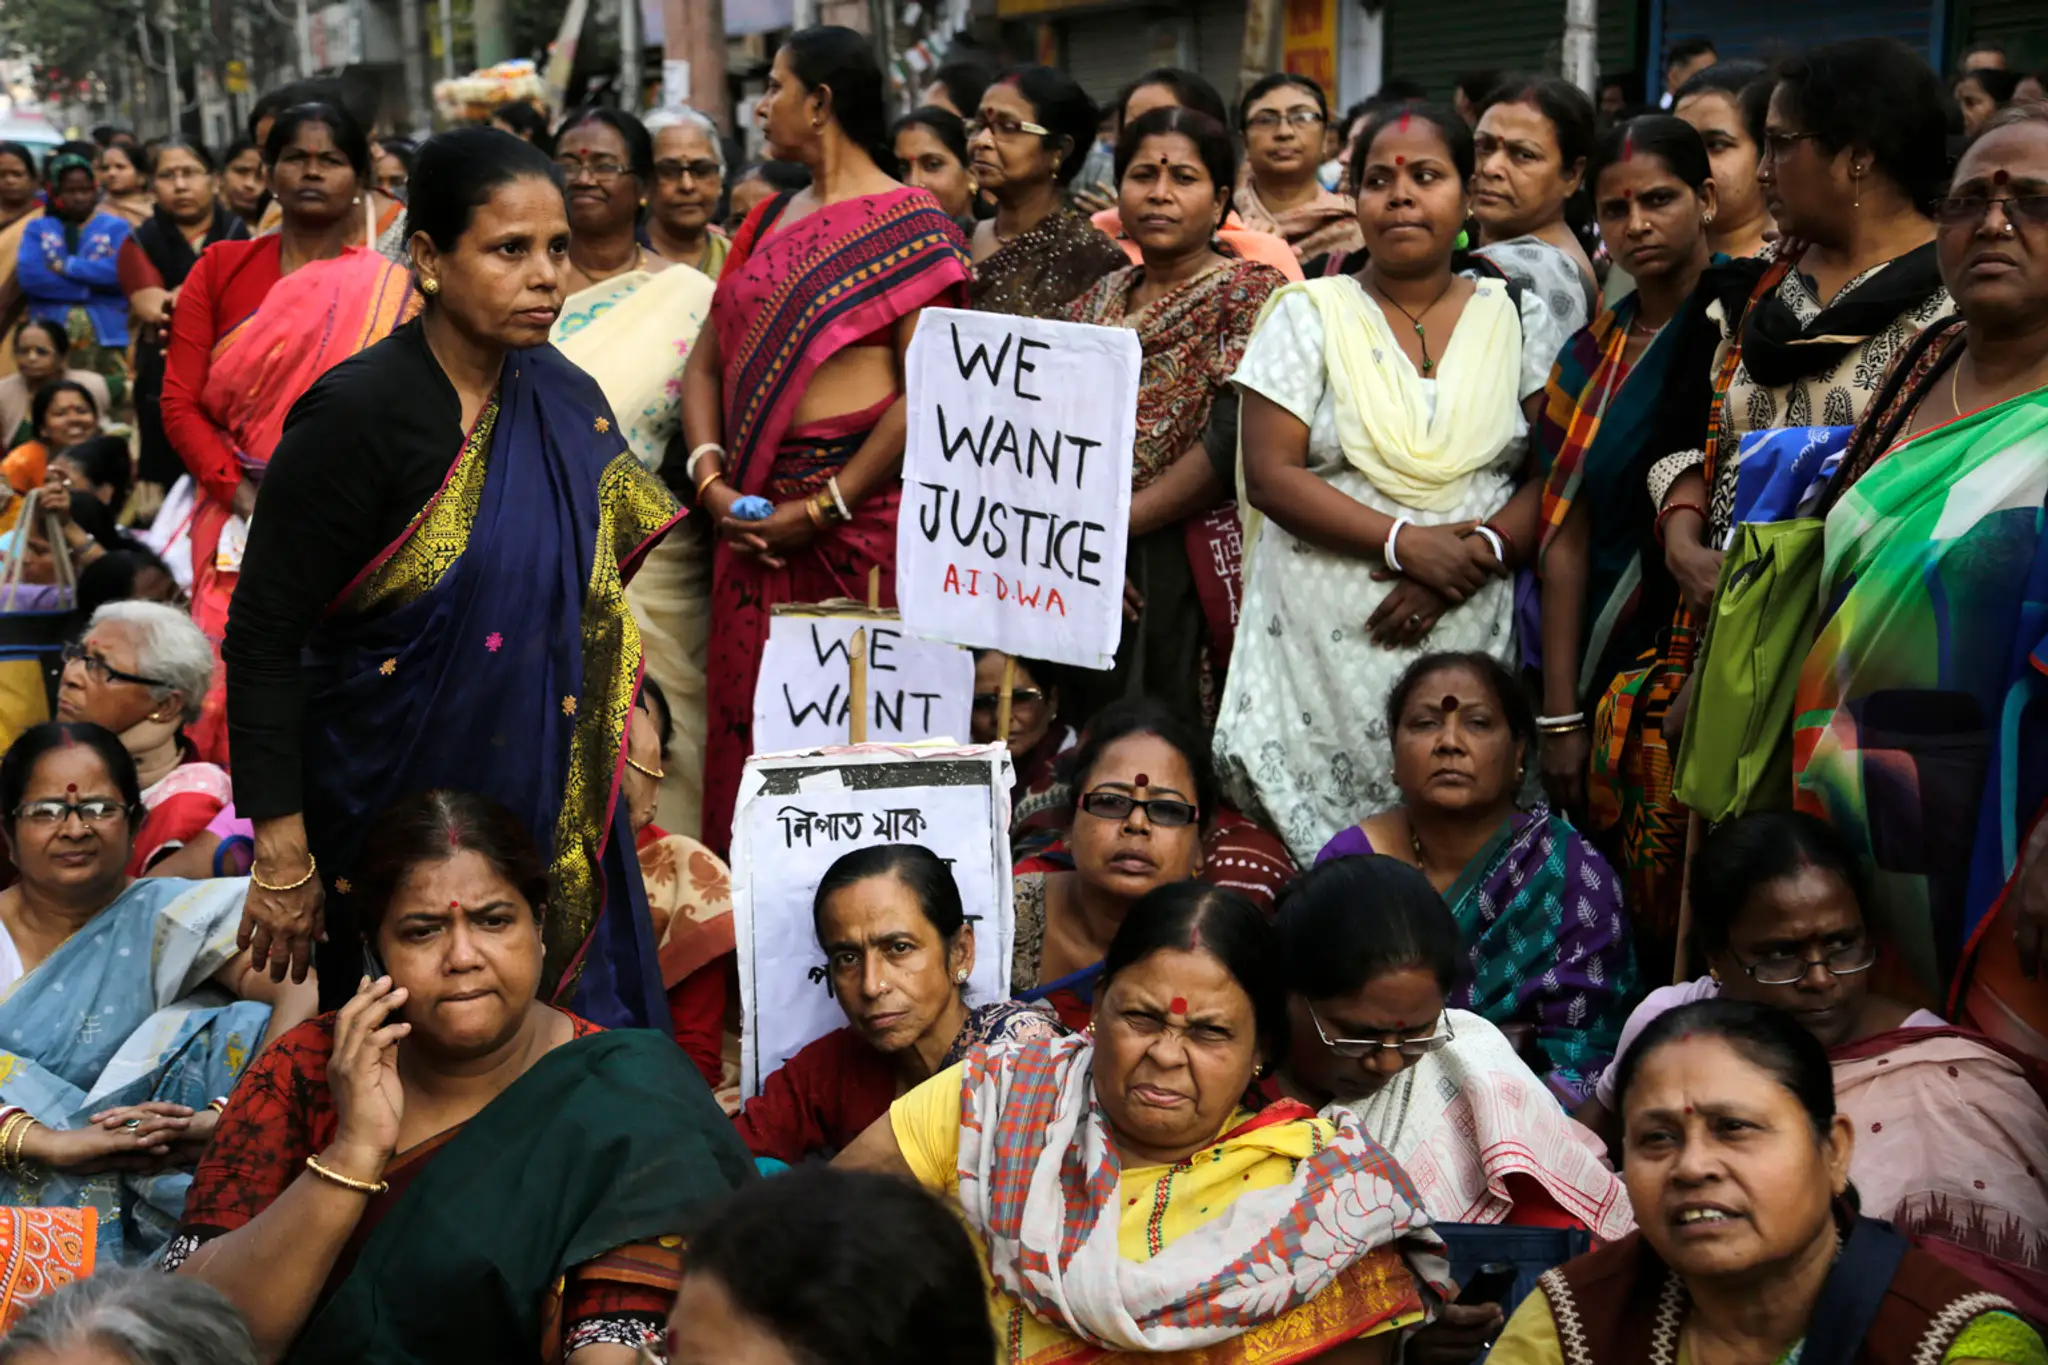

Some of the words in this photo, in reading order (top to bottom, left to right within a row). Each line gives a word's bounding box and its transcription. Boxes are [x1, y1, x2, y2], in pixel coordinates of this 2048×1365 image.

[950, 322, 1051, 400] WE
[936, 404, 1102, 489] WANT
[919, 482, 1105, 587] JUSTICE
[776, 805, 864, 848] নিপাত
[872, 808, 927, 841] যাক
